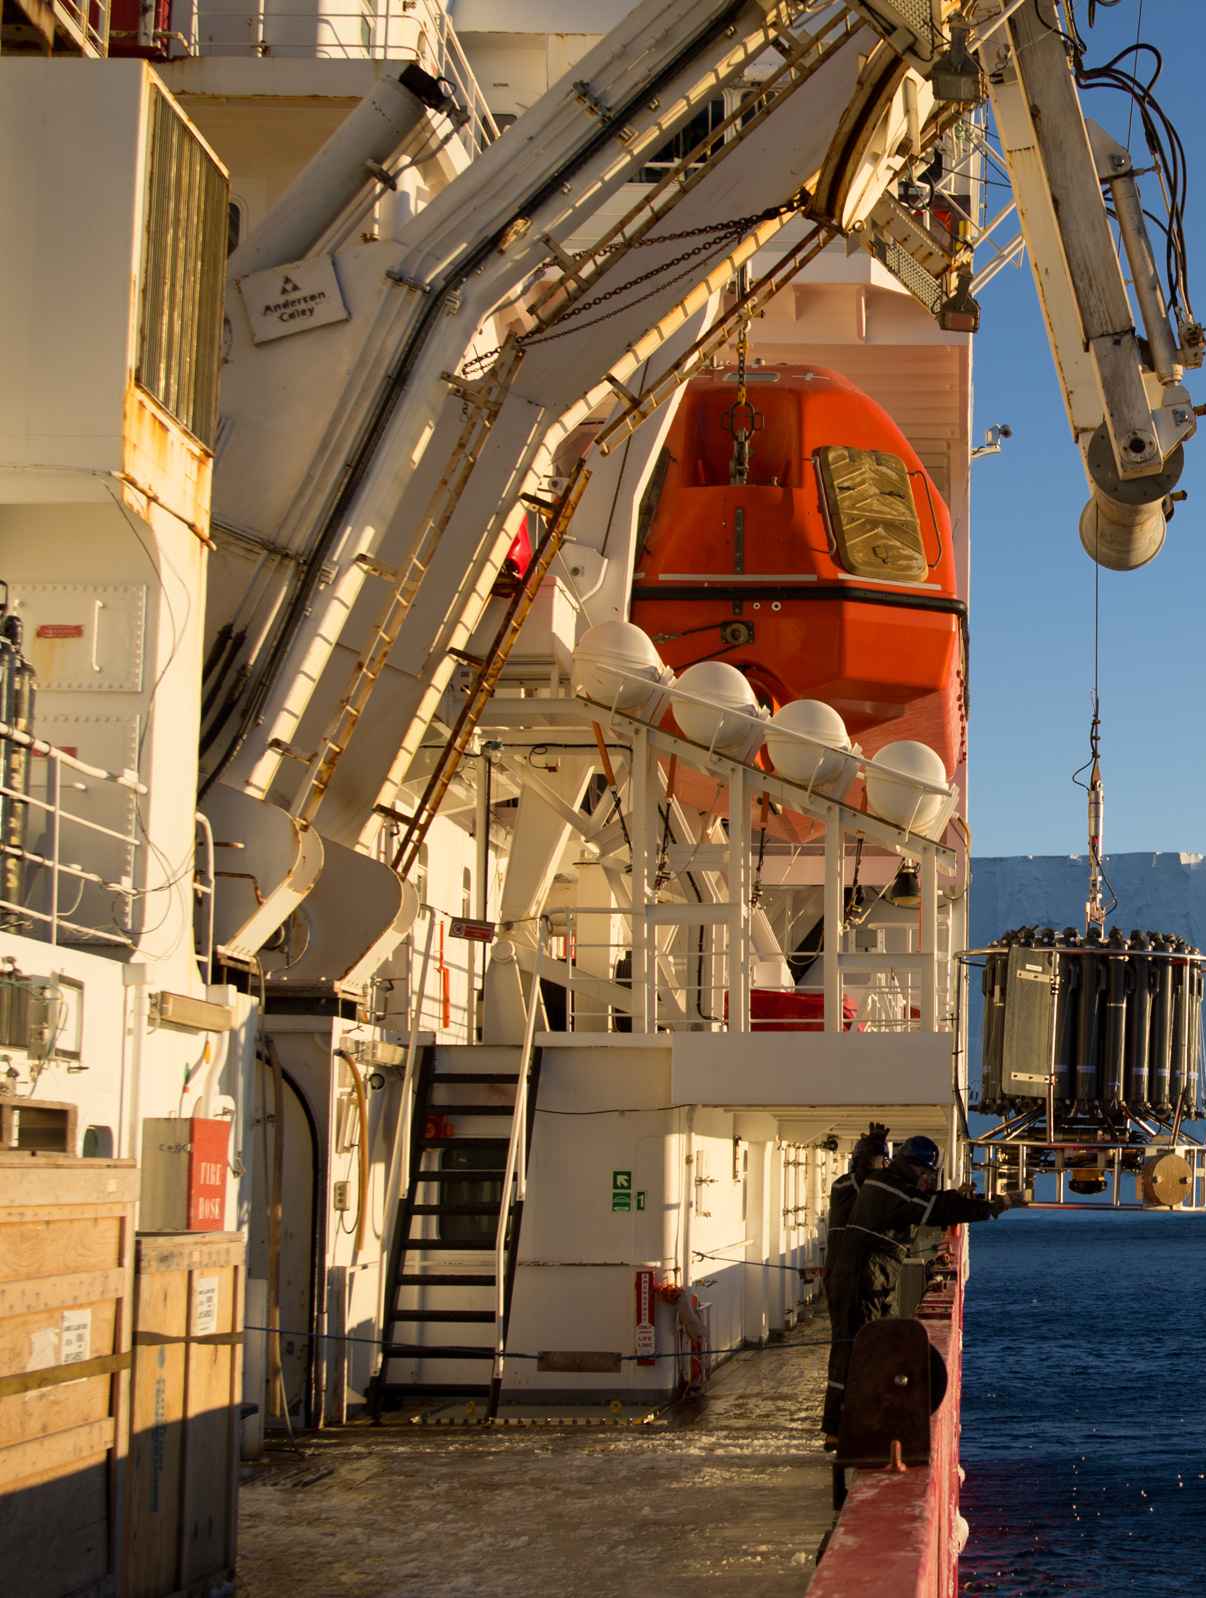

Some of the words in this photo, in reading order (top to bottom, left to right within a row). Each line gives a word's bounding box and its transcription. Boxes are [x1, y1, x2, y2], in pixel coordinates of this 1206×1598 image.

[279, 306, 315, 322] Caley
[200, 1162, 222, 1186] FIRE
[198, 1197, 221, 1220] HOSE
[638, 1194, 644, 1208] 1
